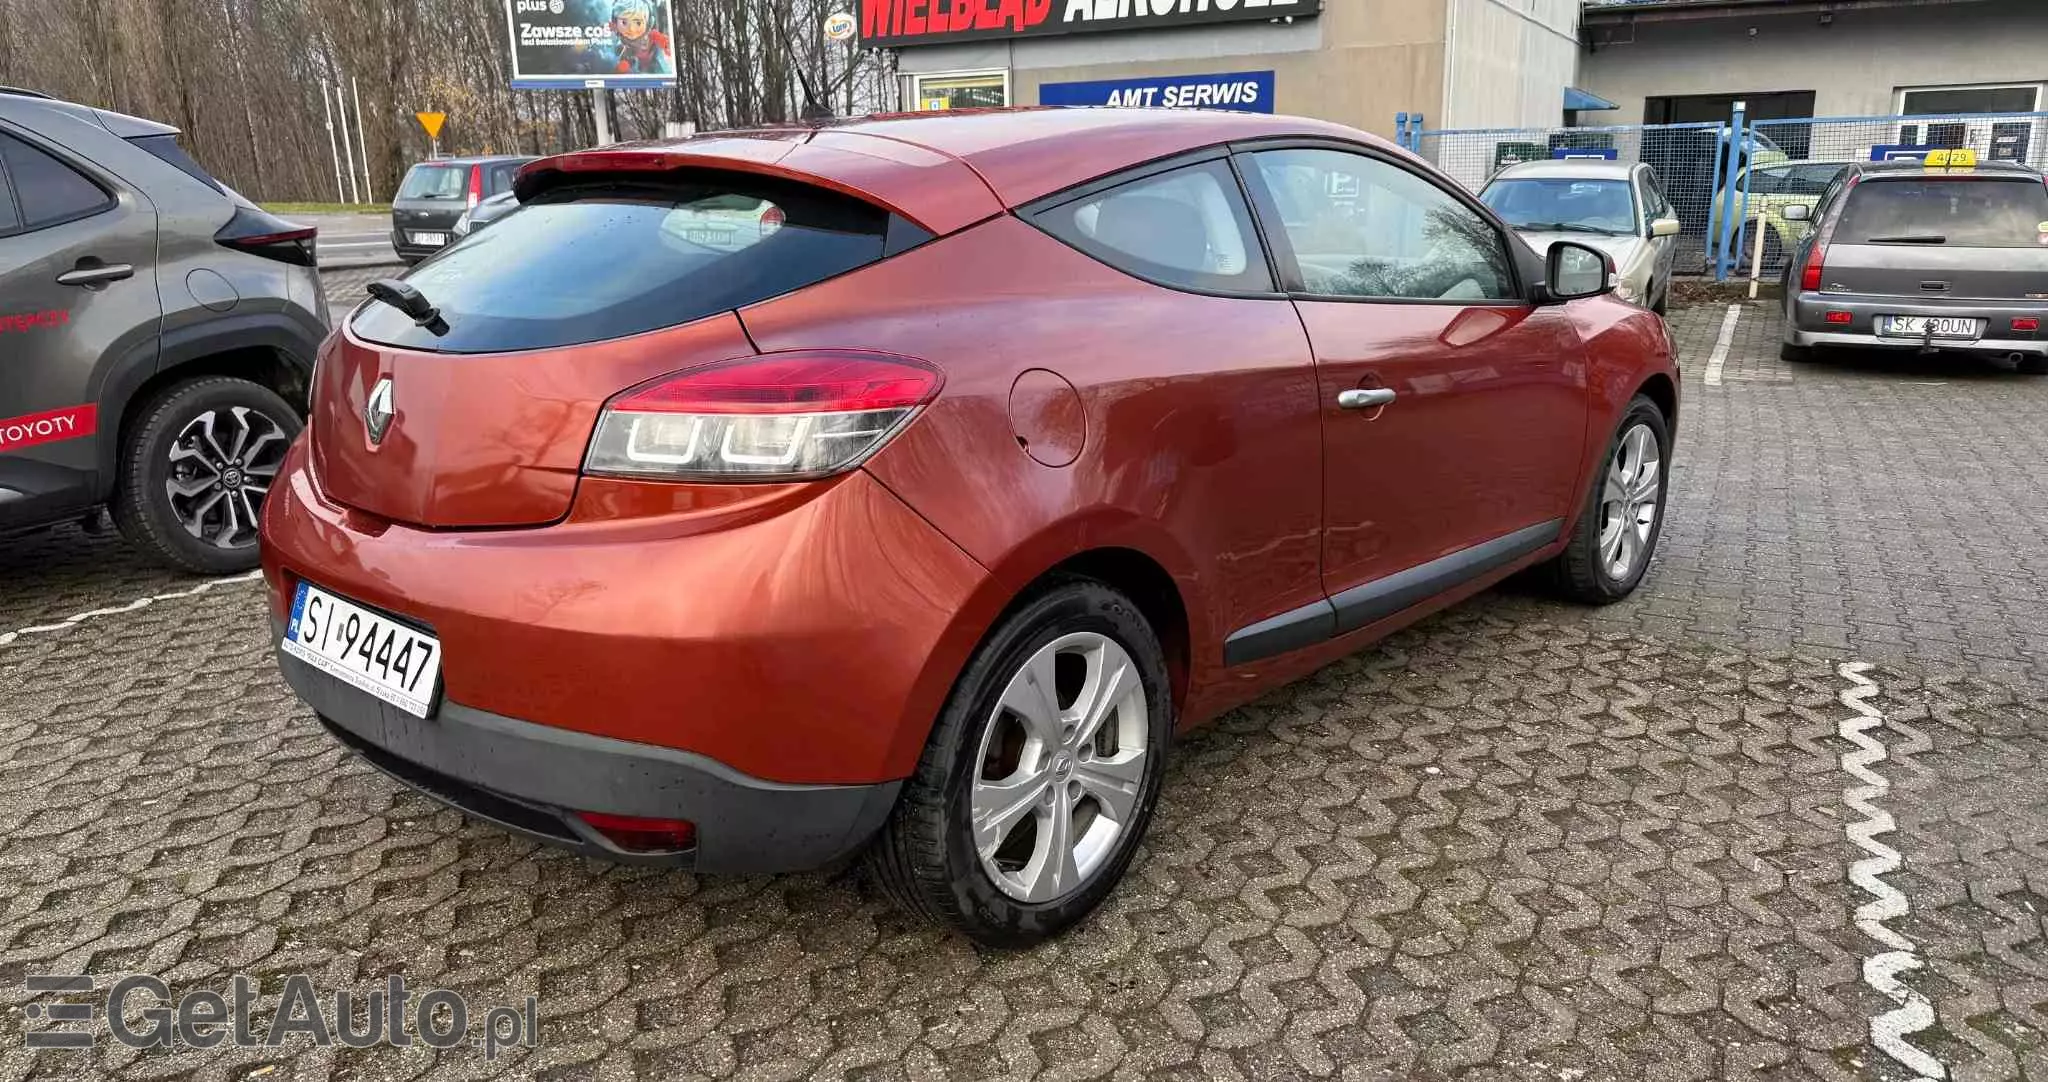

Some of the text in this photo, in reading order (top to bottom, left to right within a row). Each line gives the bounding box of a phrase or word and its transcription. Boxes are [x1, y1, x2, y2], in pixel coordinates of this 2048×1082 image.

[520, 23, 582, 38] Zawsze
[1106, 81, 1259, 107] AMT SERWIS
[1895, 317, 1914, 331] SK
[0, 414, 76, 445] TOYOTY
[304, 595, 334, 651] SI
[340, 612, 434, 693] 94447
